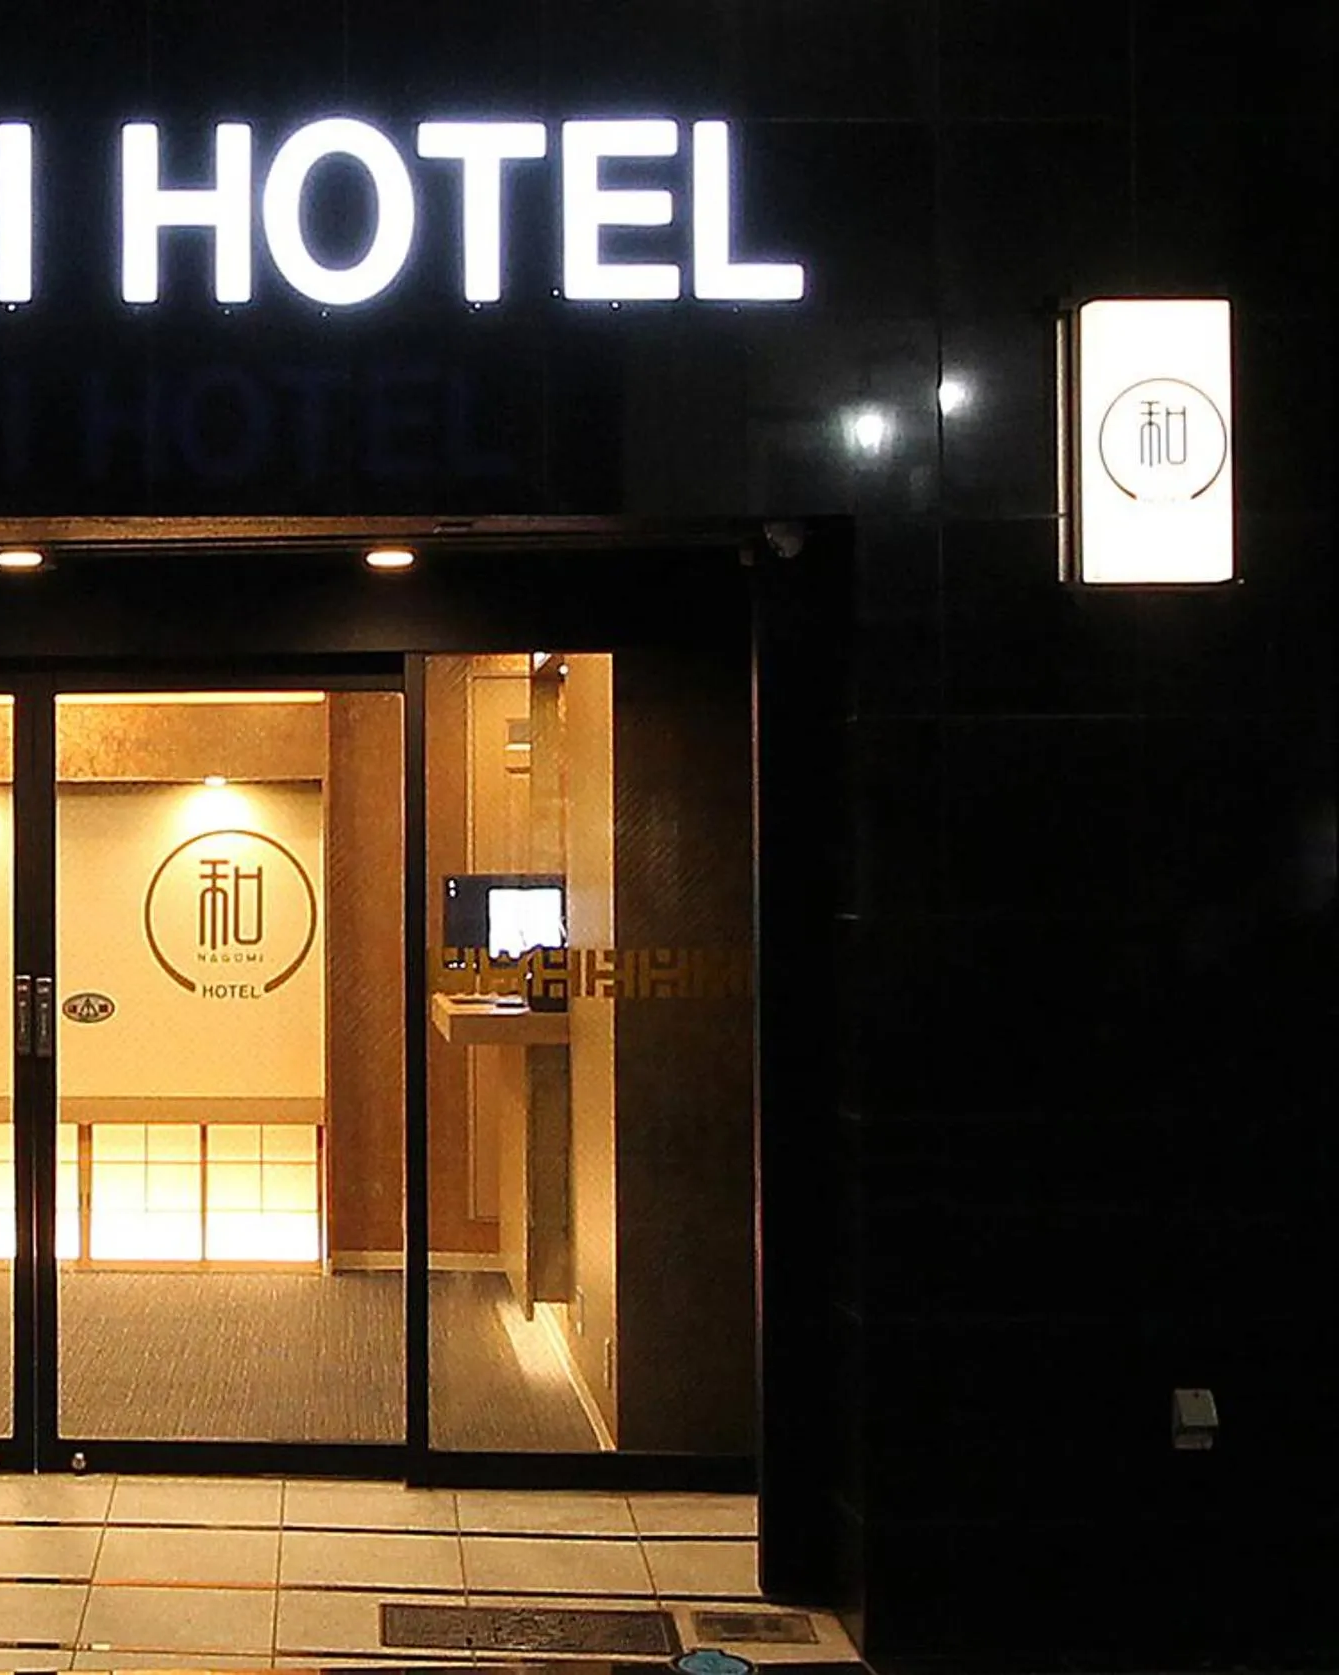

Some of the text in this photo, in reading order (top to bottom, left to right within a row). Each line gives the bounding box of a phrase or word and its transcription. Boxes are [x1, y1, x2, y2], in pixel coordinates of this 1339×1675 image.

[122, 118, 804, 306] HOTEL
[81, 362, 517, 482] HOTEL
[199, 860, 263, 950] 和
[197, 952, 264, 963] NAGOMI
[202, 984, 261, 999] HOTEL
